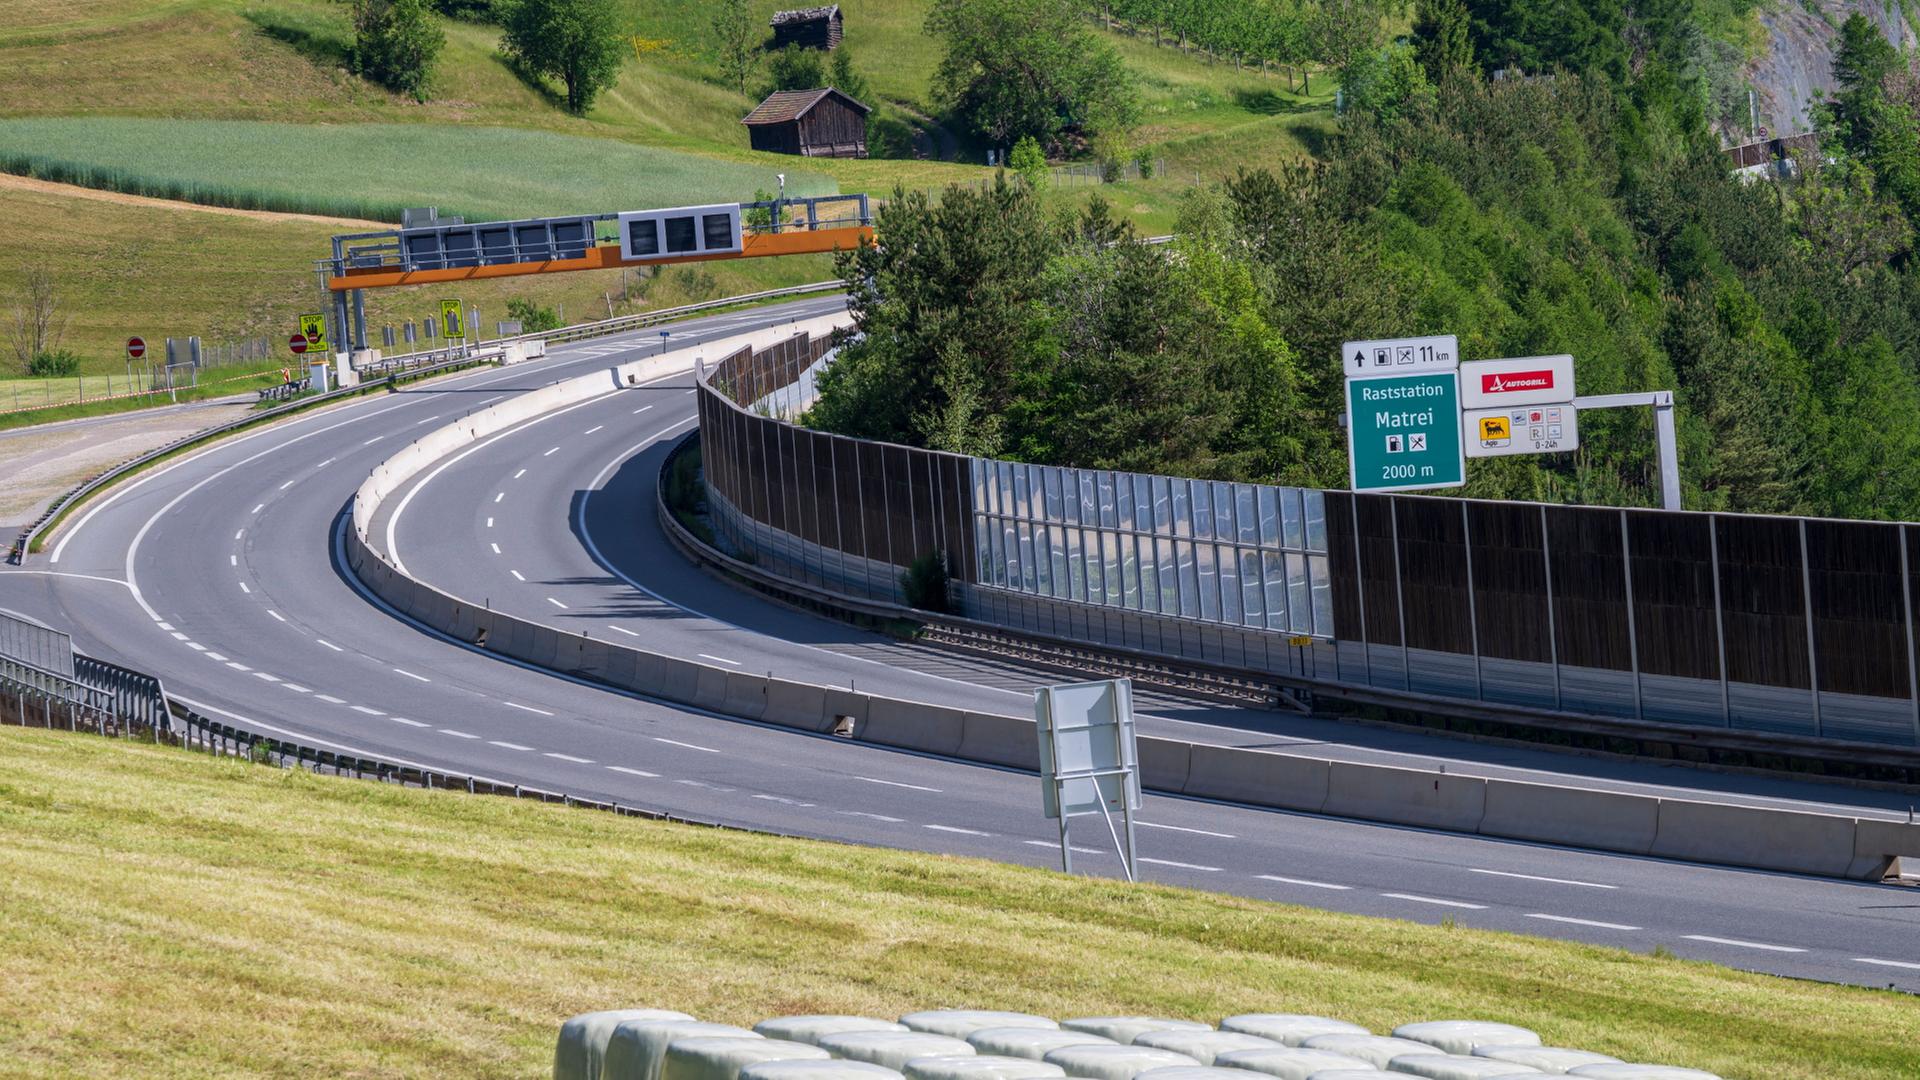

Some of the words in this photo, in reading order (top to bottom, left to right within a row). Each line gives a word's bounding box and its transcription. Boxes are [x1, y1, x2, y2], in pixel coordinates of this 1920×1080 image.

[1420, 346, 1434, 362] 11
[1436, 351, 1449, 361] km
[1506, 379, 1547, 388] AUTOGRILL
[1363, 384, 1443, 400] Raststation
[1376, 408, 1433, 428] Matrei
[1382, 465, 1416, 480] 2000
[1421, 466, 1434, 477] m
